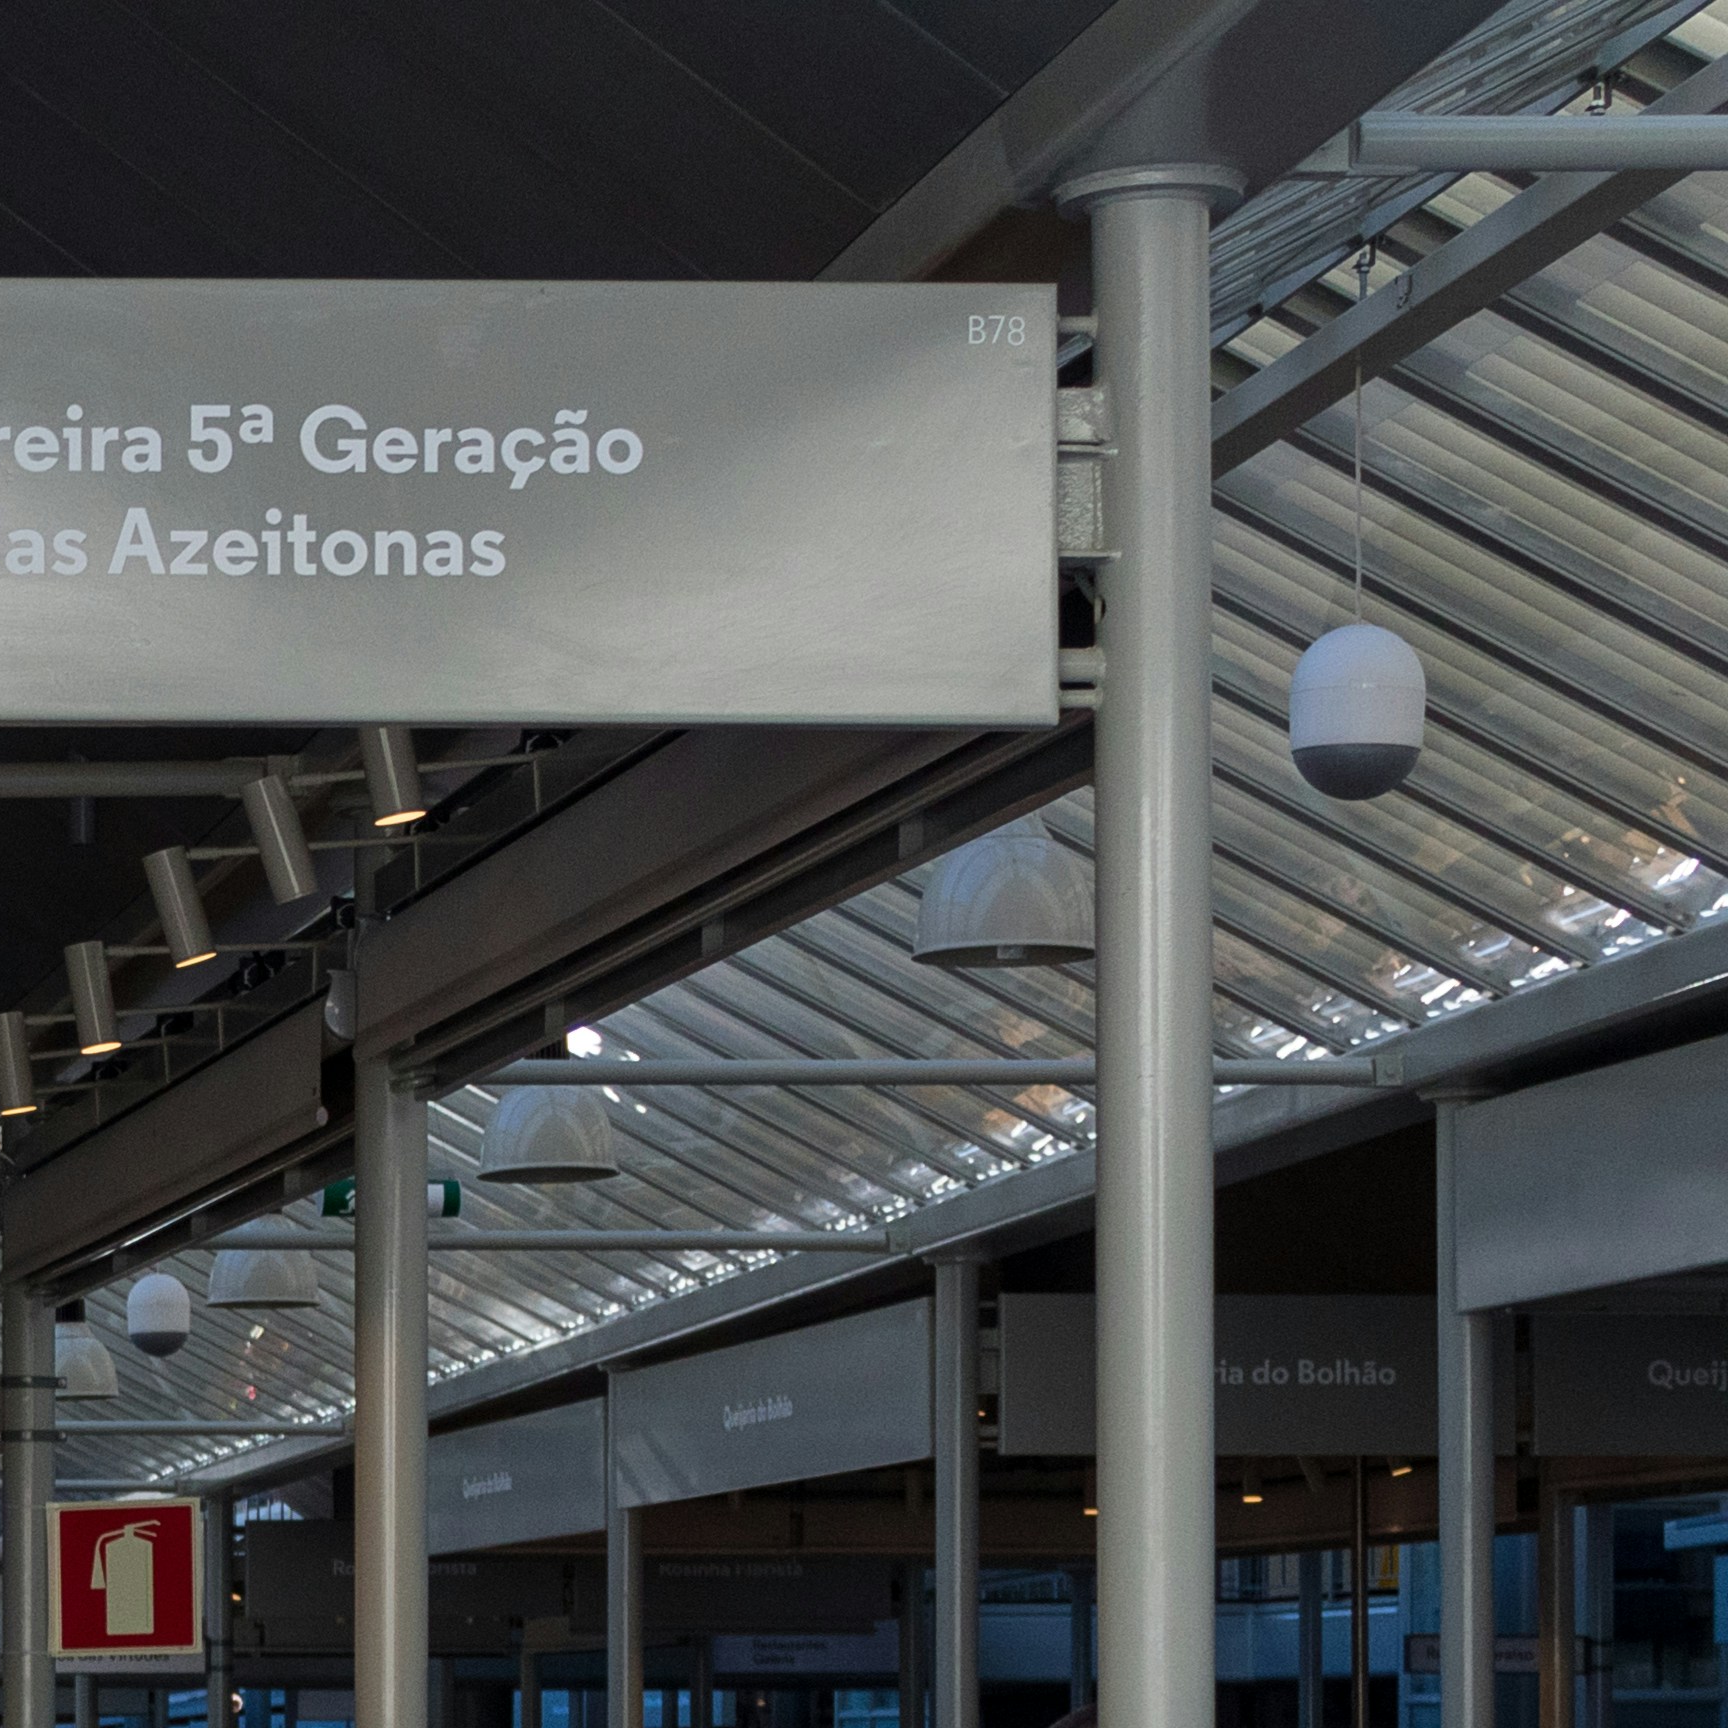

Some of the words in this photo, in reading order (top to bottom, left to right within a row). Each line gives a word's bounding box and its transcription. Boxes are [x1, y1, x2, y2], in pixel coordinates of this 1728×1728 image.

[968, 314, 1026, 346] B78
[187, 403, 274, 474] 5ª
[299, 403, 644, 487] Geração
[108, 507, 506, 577] Azeitonas
[1252, 1359, 1290, 1386] do
[1298, 1358, 1397, 1387] Bolhão
